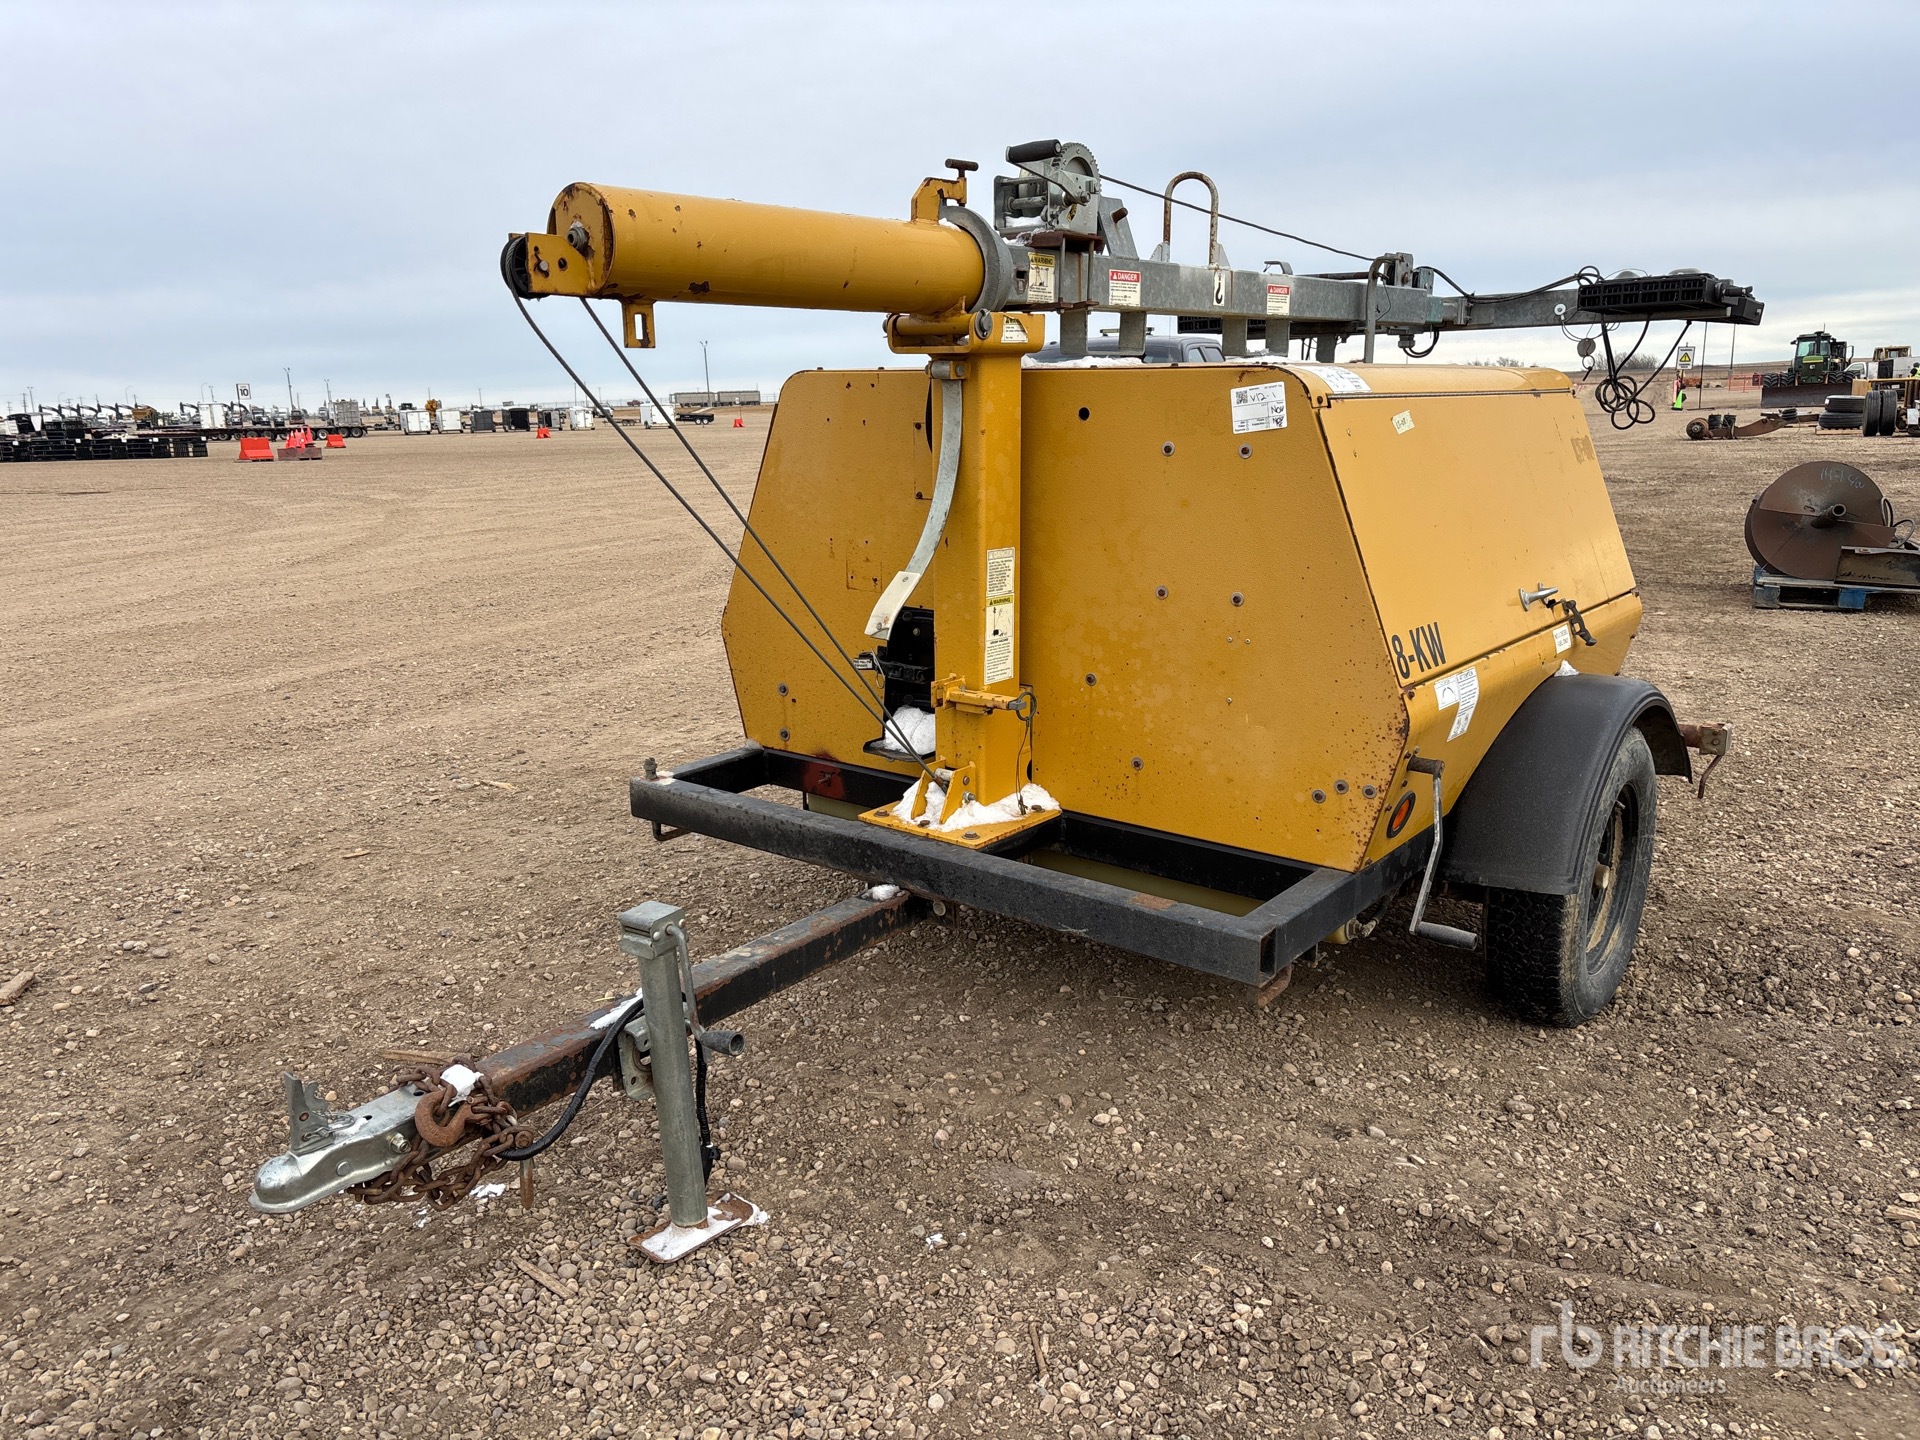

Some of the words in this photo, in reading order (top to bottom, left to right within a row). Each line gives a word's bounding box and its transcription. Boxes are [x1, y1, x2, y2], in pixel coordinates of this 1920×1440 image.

[1117, 272, 1138, 281] DANGER
[239, 388, 248, 396] 10
[1391, 621, 1447, 679] 8-KW
